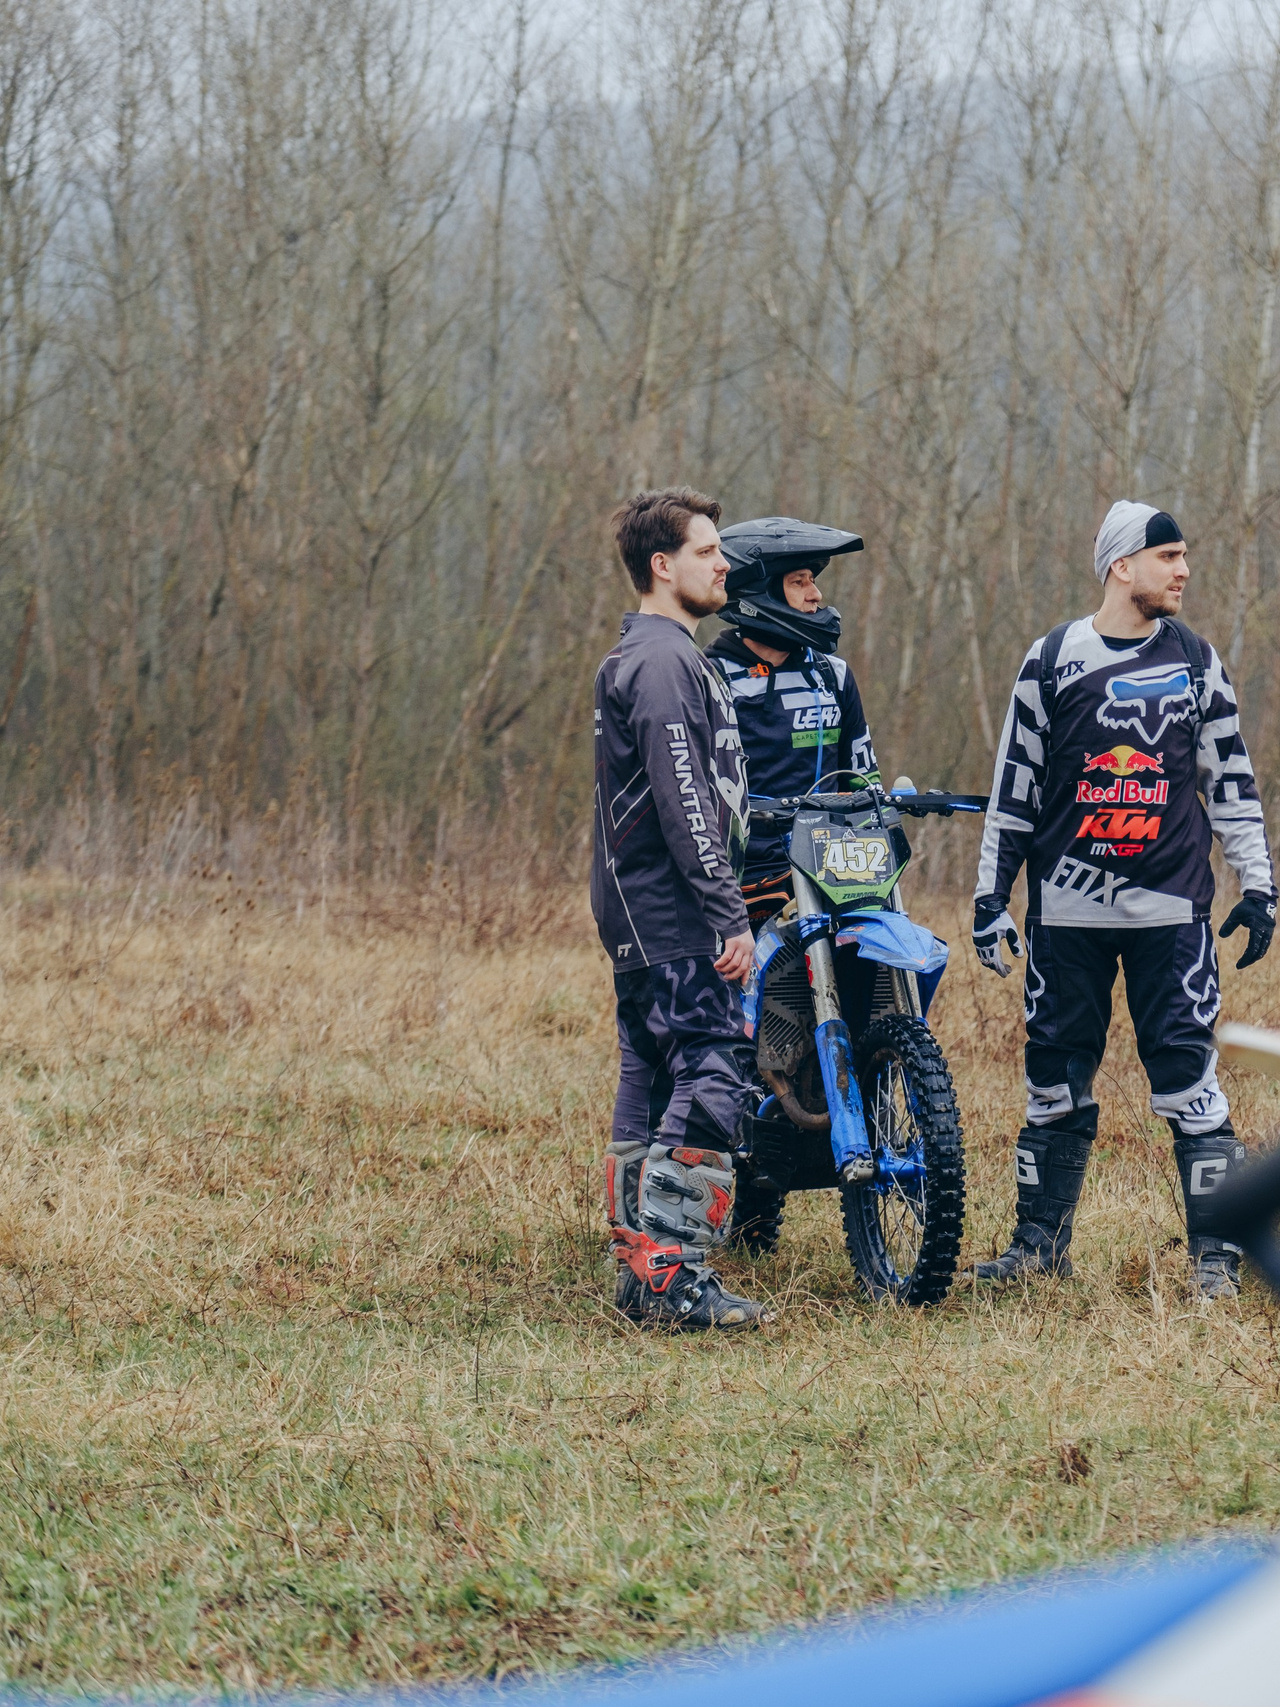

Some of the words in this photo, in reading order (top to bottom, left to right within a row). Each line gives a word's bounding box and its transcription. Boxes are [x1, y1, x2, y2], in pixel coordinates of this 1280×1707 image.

[663, 722, 720, 879] FINNTRAIL
[1076, 779, 1122, 803] Red
[1123, 780, 1169, 804] Bull
[1076, 808, 1162, 839] KTM
[826, 841, 887, 873] 452
[1090, 843, 1144, 858] MXGP
[1049, 855, 1130, 908] FOX
[617, 943, 633, 958] FT
[1015, 1147, 1040, 1186] G
[1190, 1158, 1228, 1195] G
